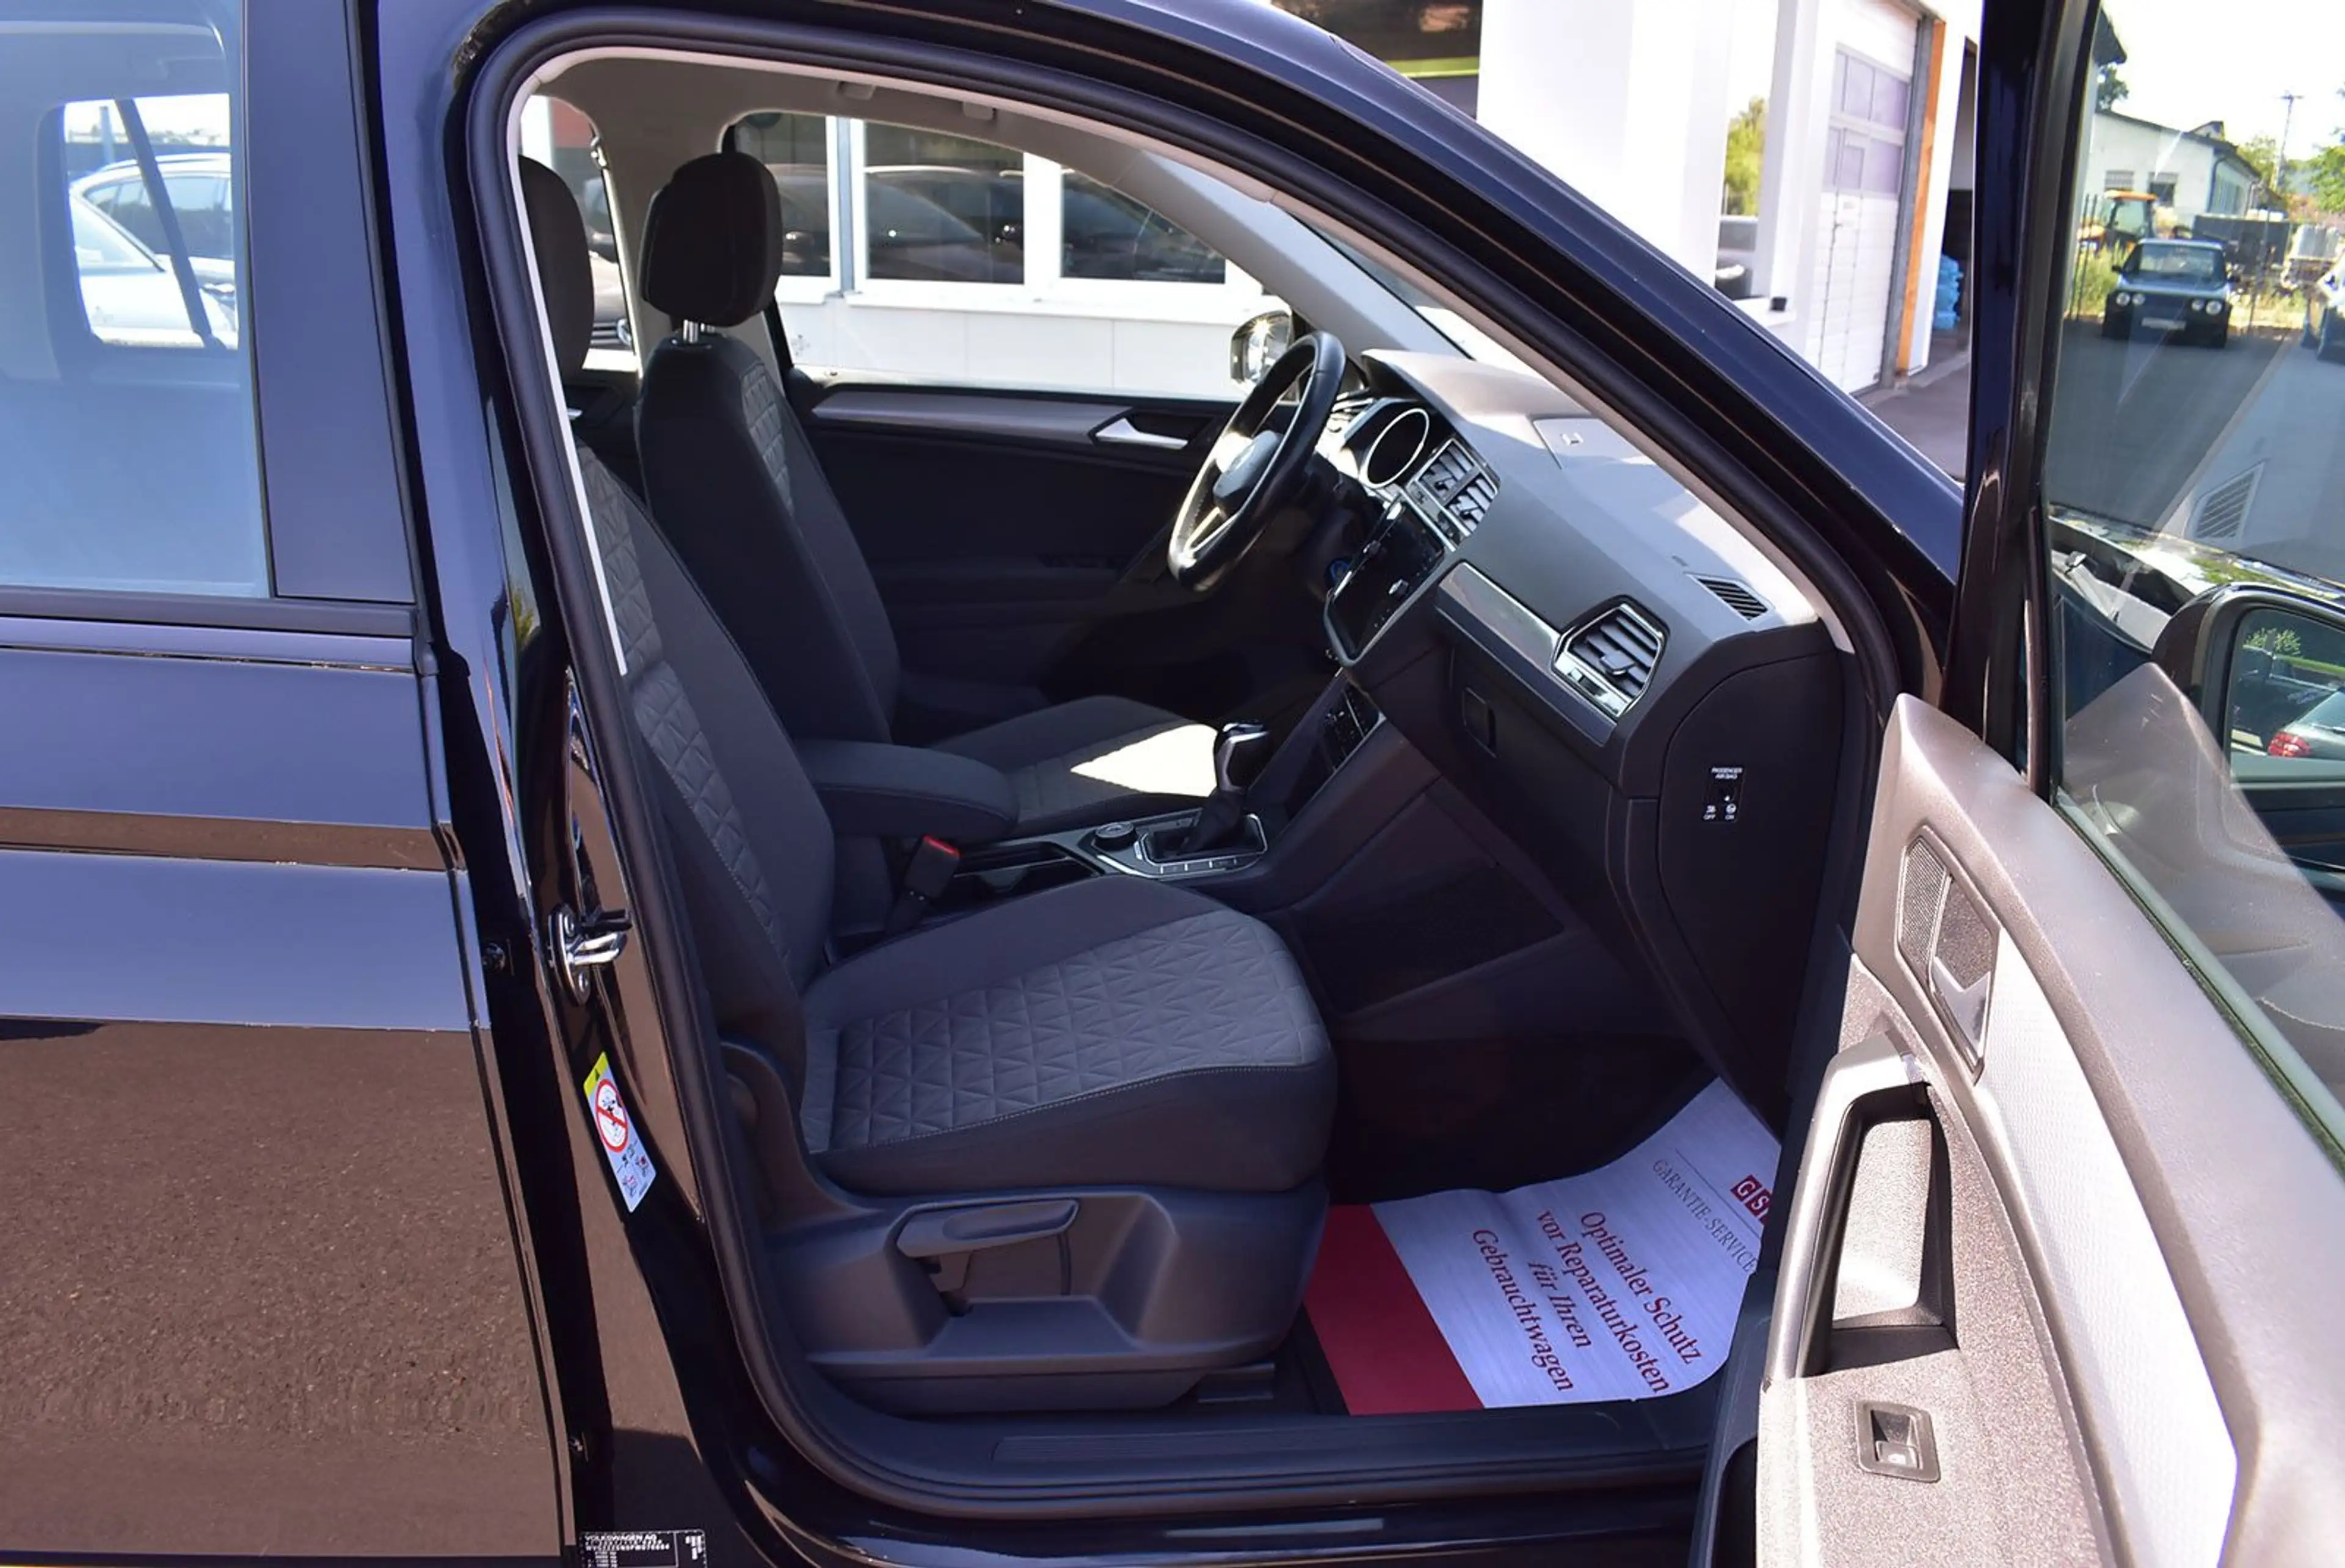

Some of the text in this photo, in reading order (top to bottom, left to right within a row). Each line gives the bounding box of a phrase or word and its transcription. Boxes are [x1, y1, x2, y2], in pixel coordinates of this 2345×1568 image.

[1472, 1229, 1574, 1392] Gebrauchtwagen
[1528, 1261, 1592, 1348] für Ihren
[1537, 1210, 1670, 1393] vor Reparaturkosten
[1580, 1211, 1702, 1365] Optimaler Schutz
